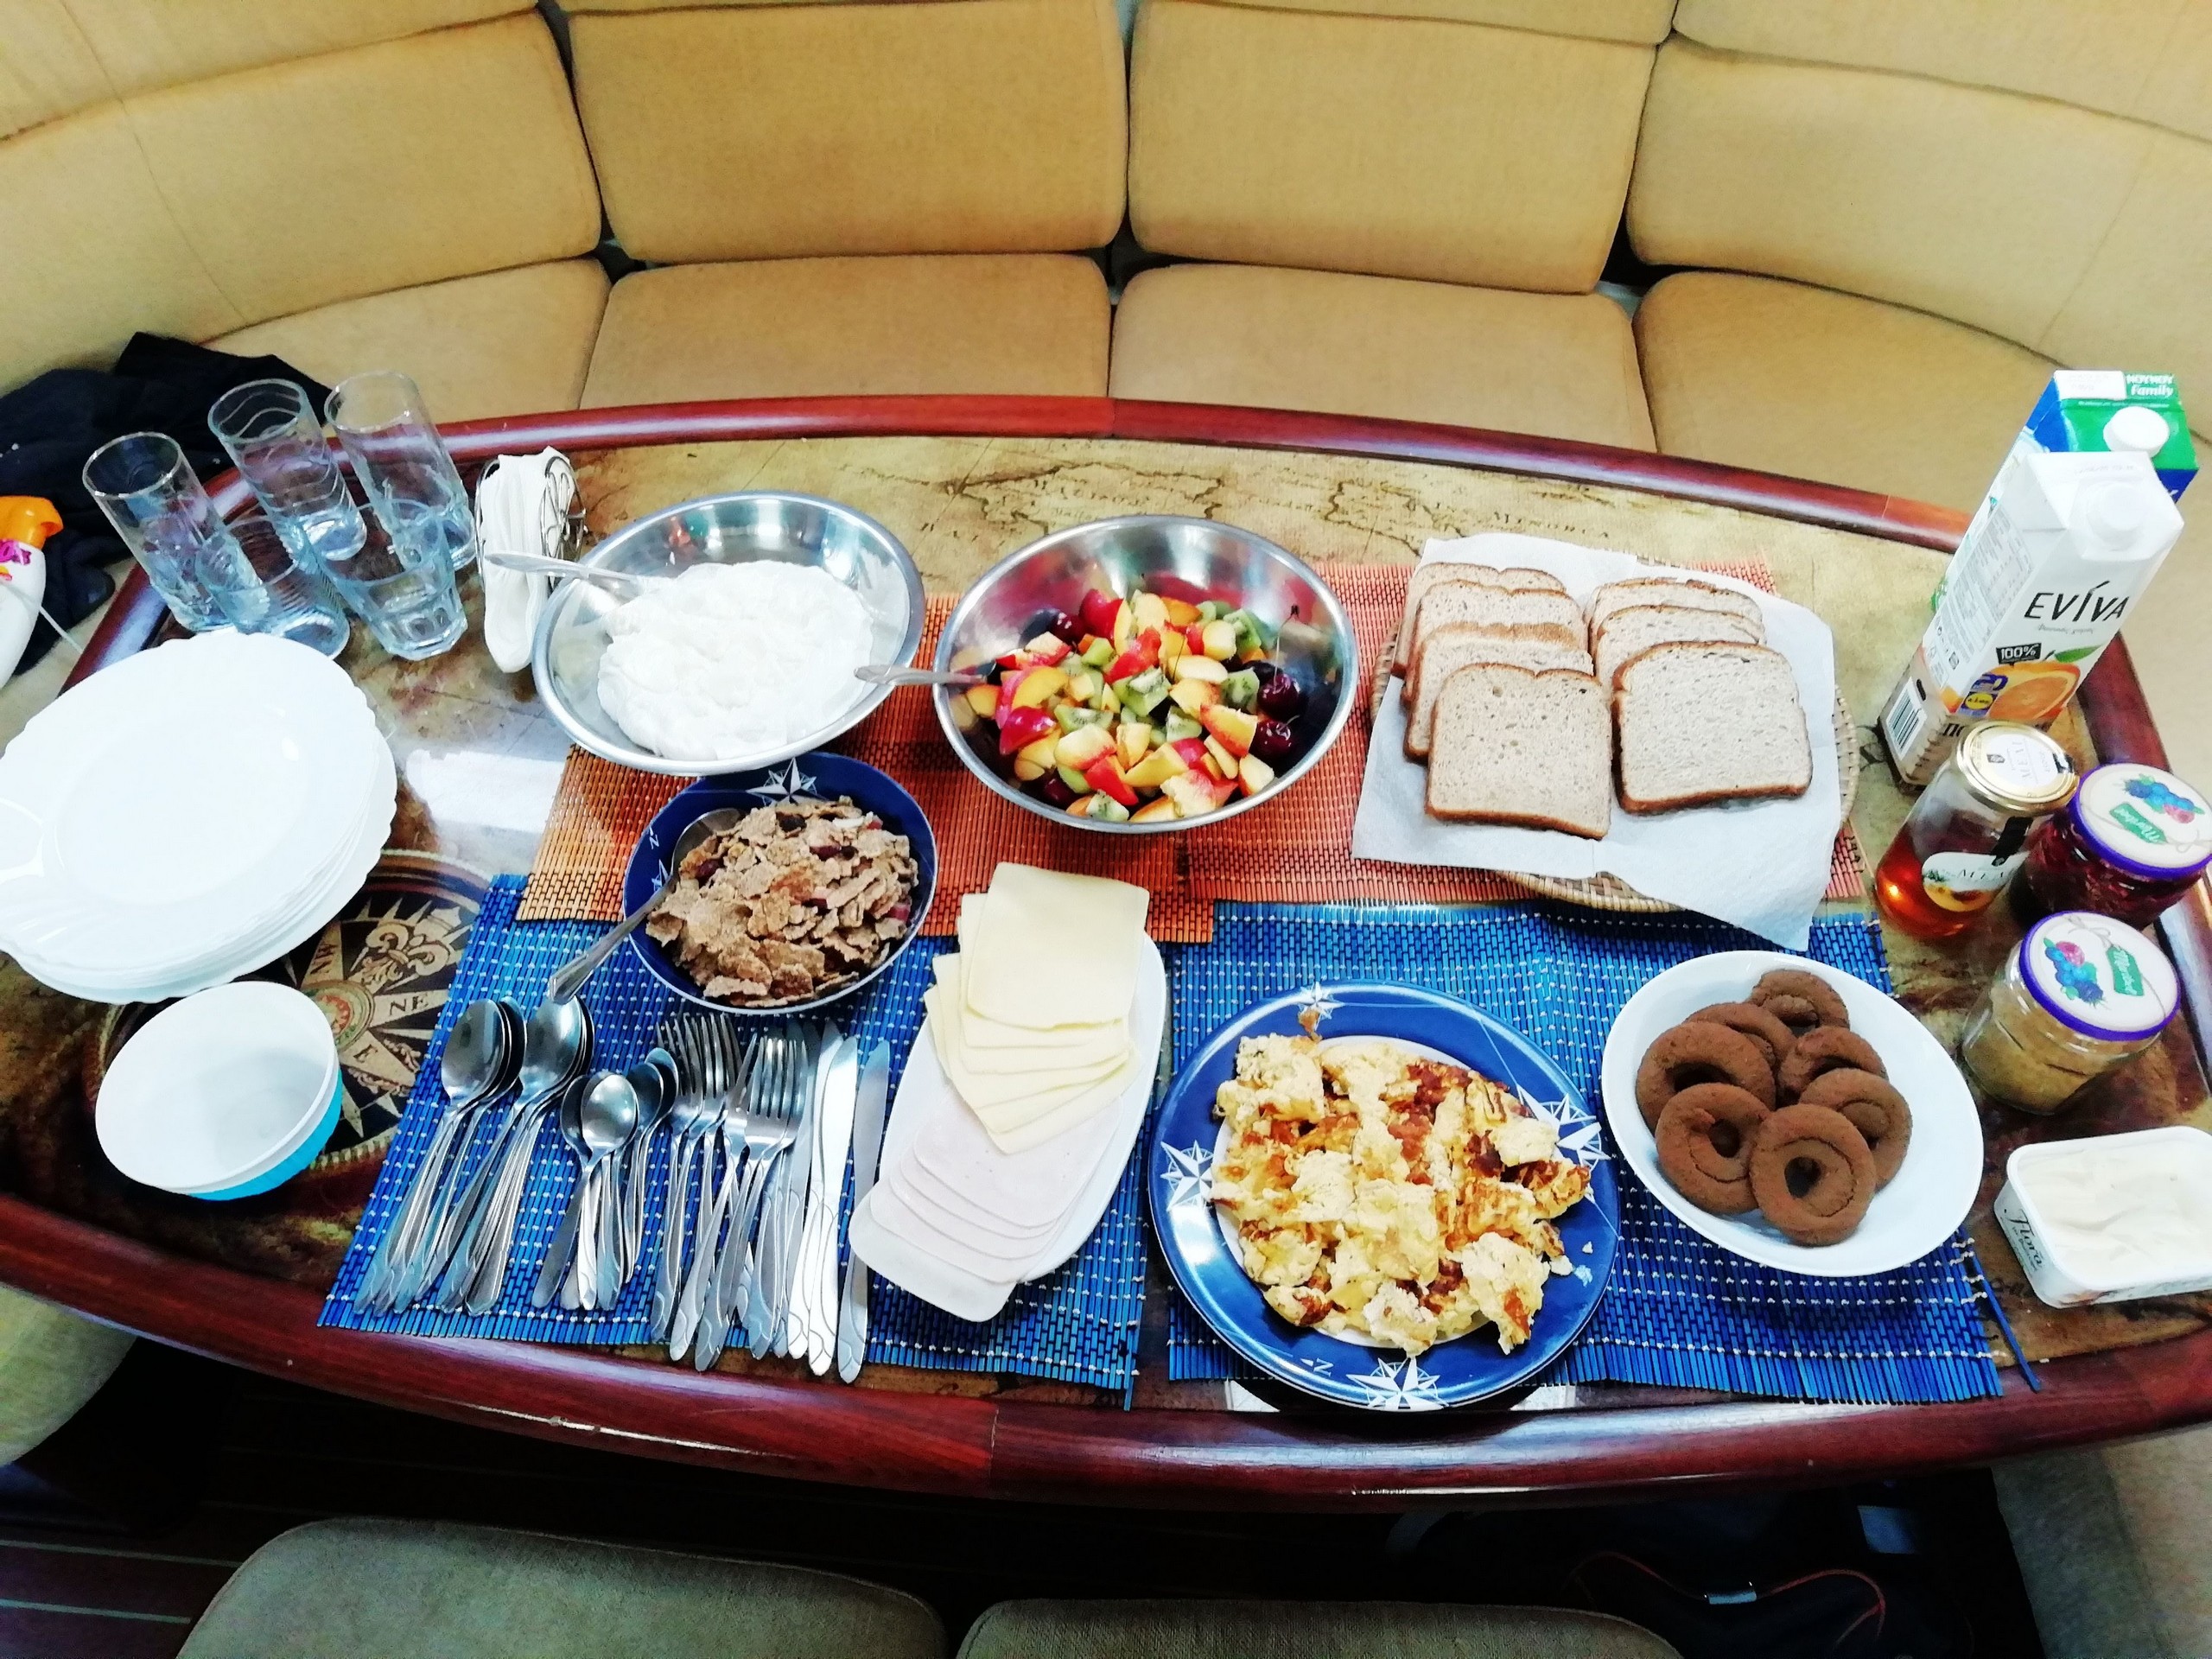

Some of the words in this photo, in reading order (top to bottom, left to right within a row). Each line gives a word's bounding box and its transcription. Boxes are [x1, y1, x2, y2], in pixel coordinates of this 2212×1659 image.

[2131, 384, 2174, 397] Family
[2000, 644, 2037, 660] 100%
[390, 994, 430, 1017] NE
[353, 1043, 379, 1064] E
[2004, 1208, 2044, 1268] Flora
